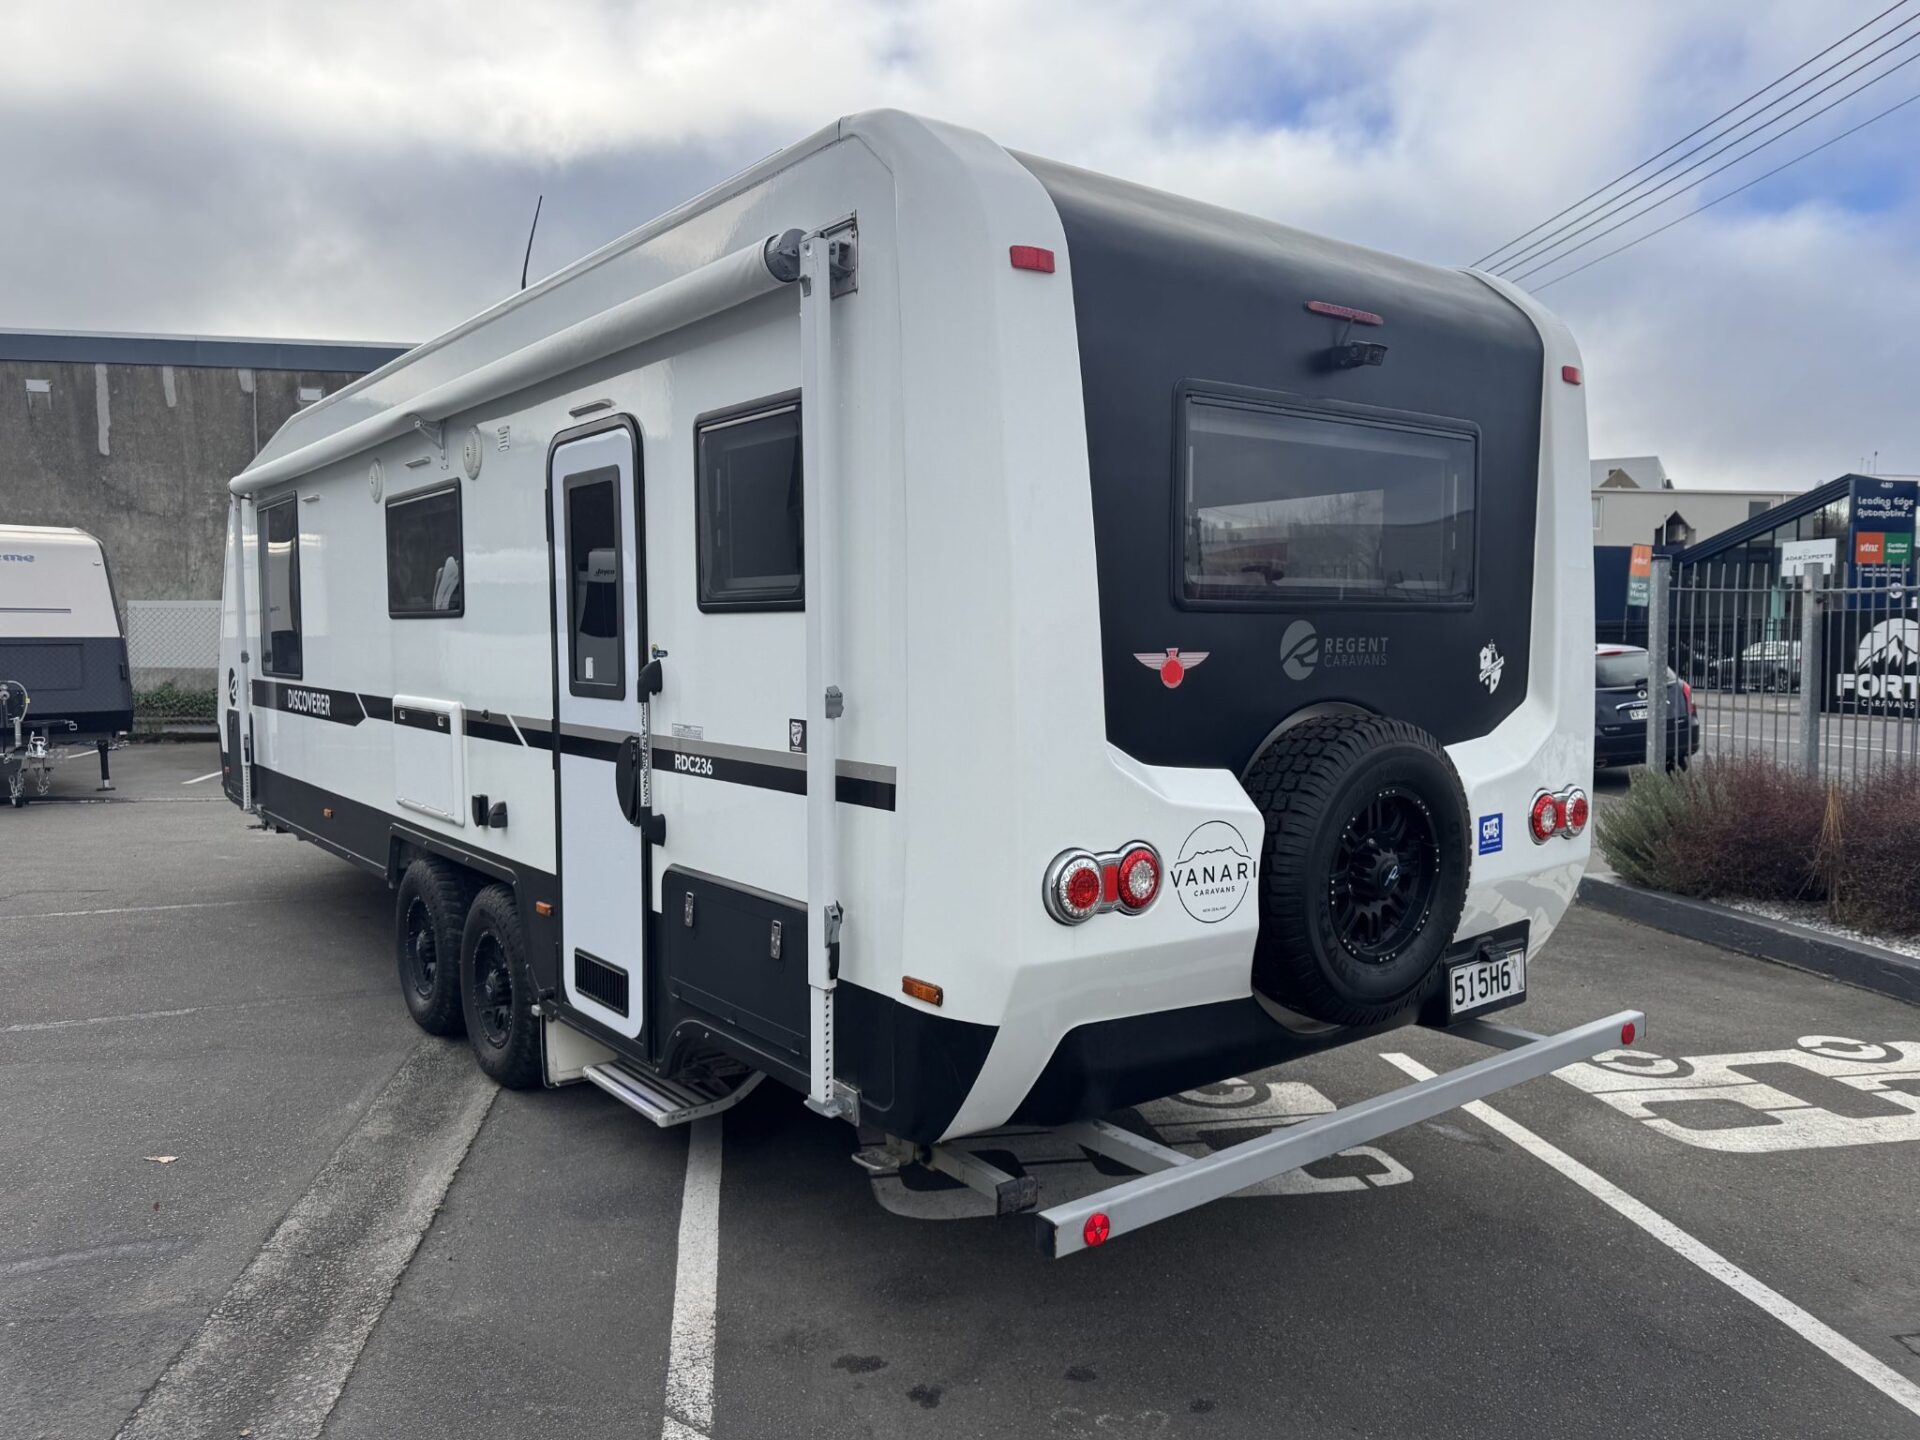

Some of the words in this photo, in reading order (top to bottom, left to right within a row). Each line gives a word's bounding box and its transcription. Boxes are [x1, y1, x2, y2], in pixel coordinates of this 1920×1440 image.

[1858, 496, 1892, 510] Leading
[1893, 496, 1914, 510] Edge
[1857, 508, 1906, 519] Automotive
[1325, 637, 1389, 653] REGENT
[1324, 653, 1388, 668] CARAVANS
[287, 688, 331, 717] DISCOVERER
[1861, 699, 1916, 709] CARAVANS
[674, 753, 713, 776] RDC236
[1170, 861, 1257, 888] VANARI
[1193, 885, 1236, 897] CARAVANS
[1454, 961, 1511, 1006] 515H6
